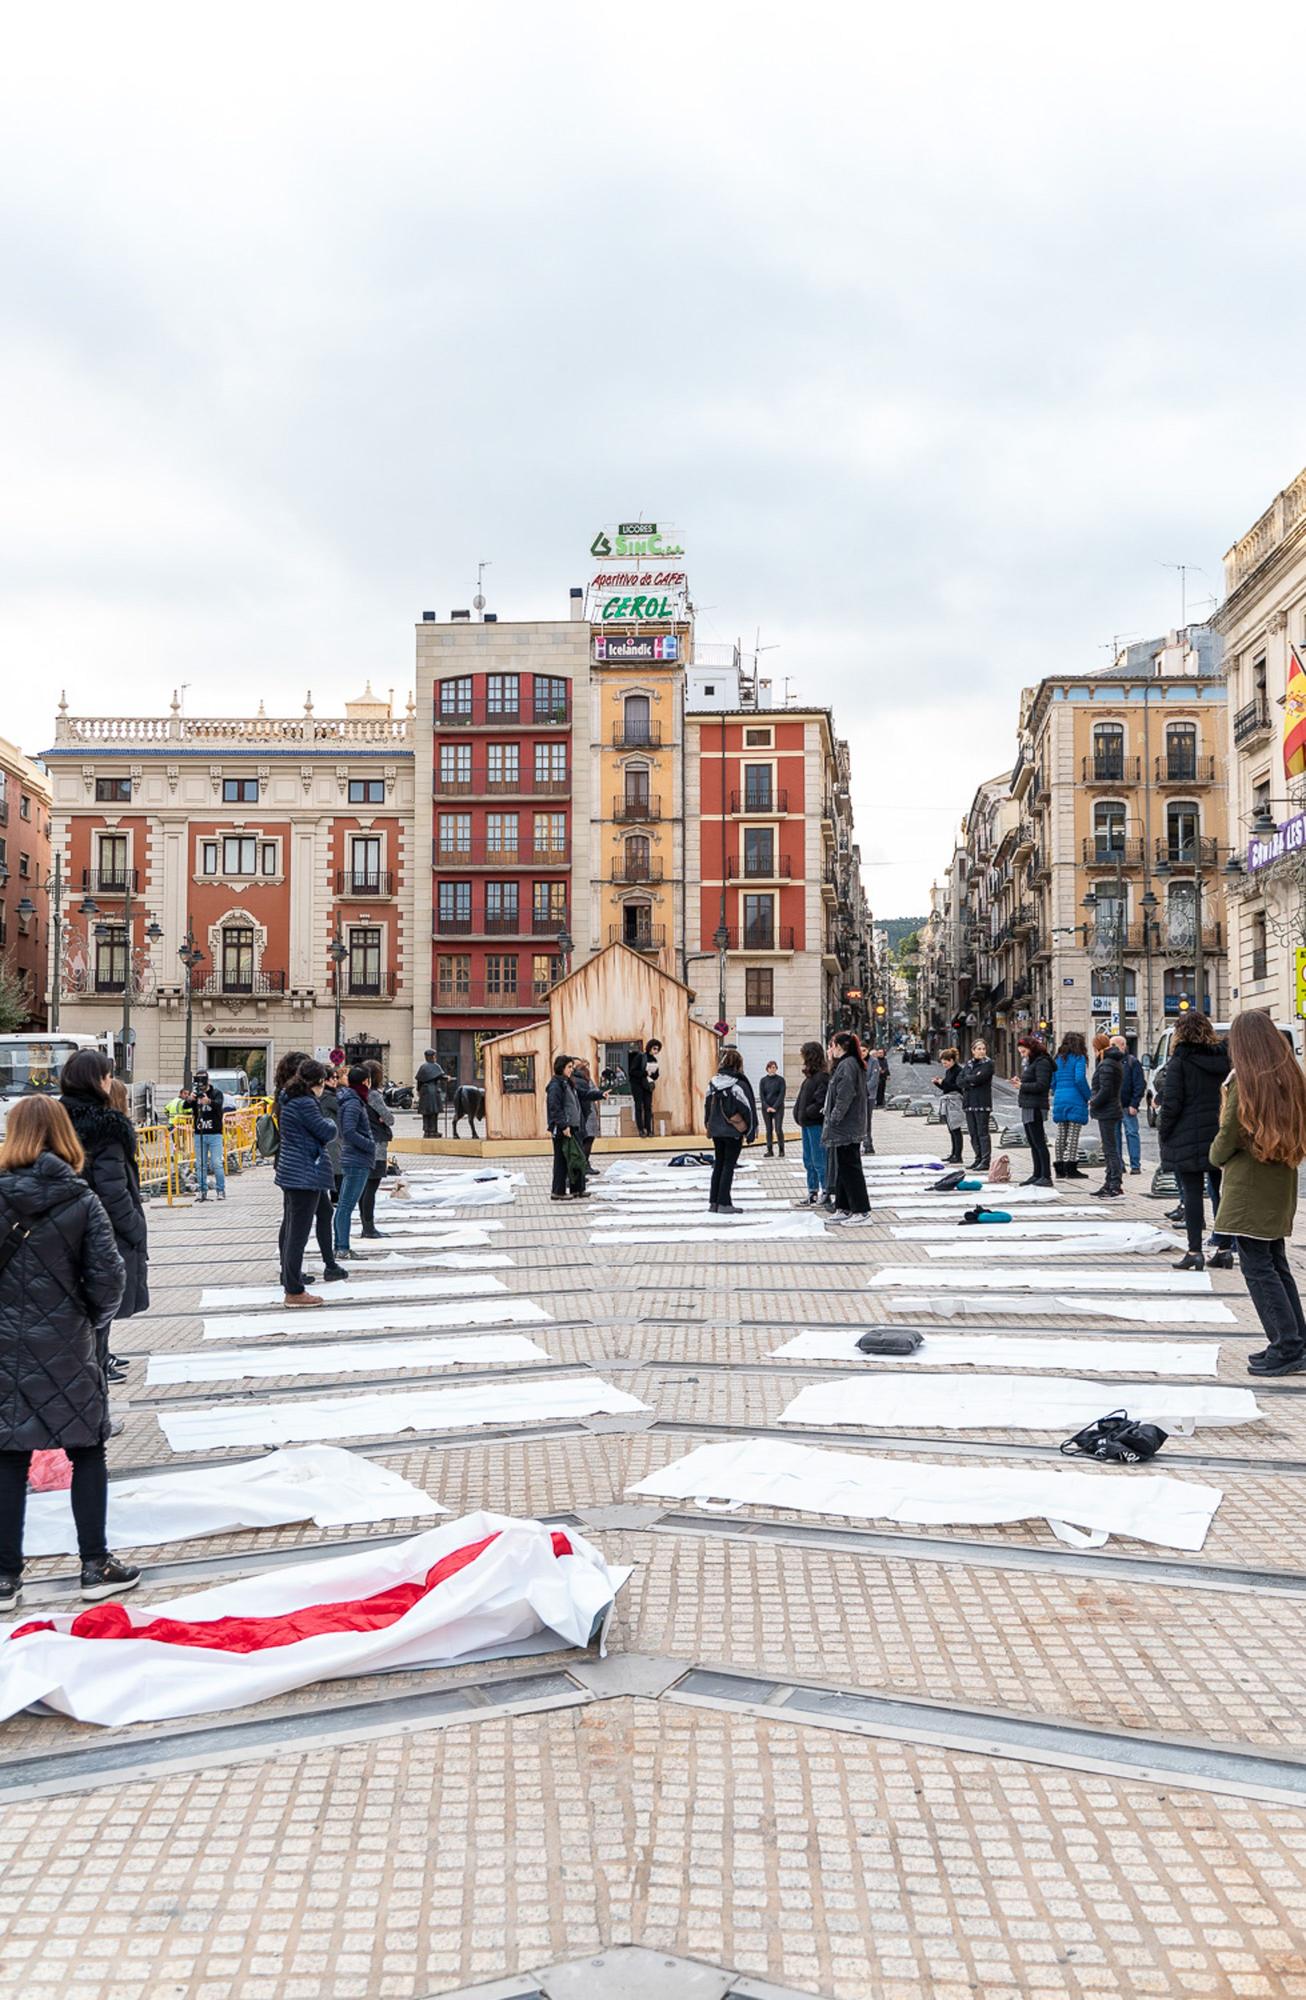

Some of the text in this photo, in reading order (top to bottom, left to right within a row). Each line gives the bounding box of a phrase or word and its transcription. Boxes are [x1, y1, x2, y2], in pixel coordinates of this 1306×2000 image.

[622, 525, 654, 534] LICORES
[592, 574, 639, 589] Aperitivo
[640, 573, 653, 586] de
[602, 595, 673, 620] CEROL
[608, 643, 652, 656] Icelandic
[1286, 819, 1303, 850] LES
